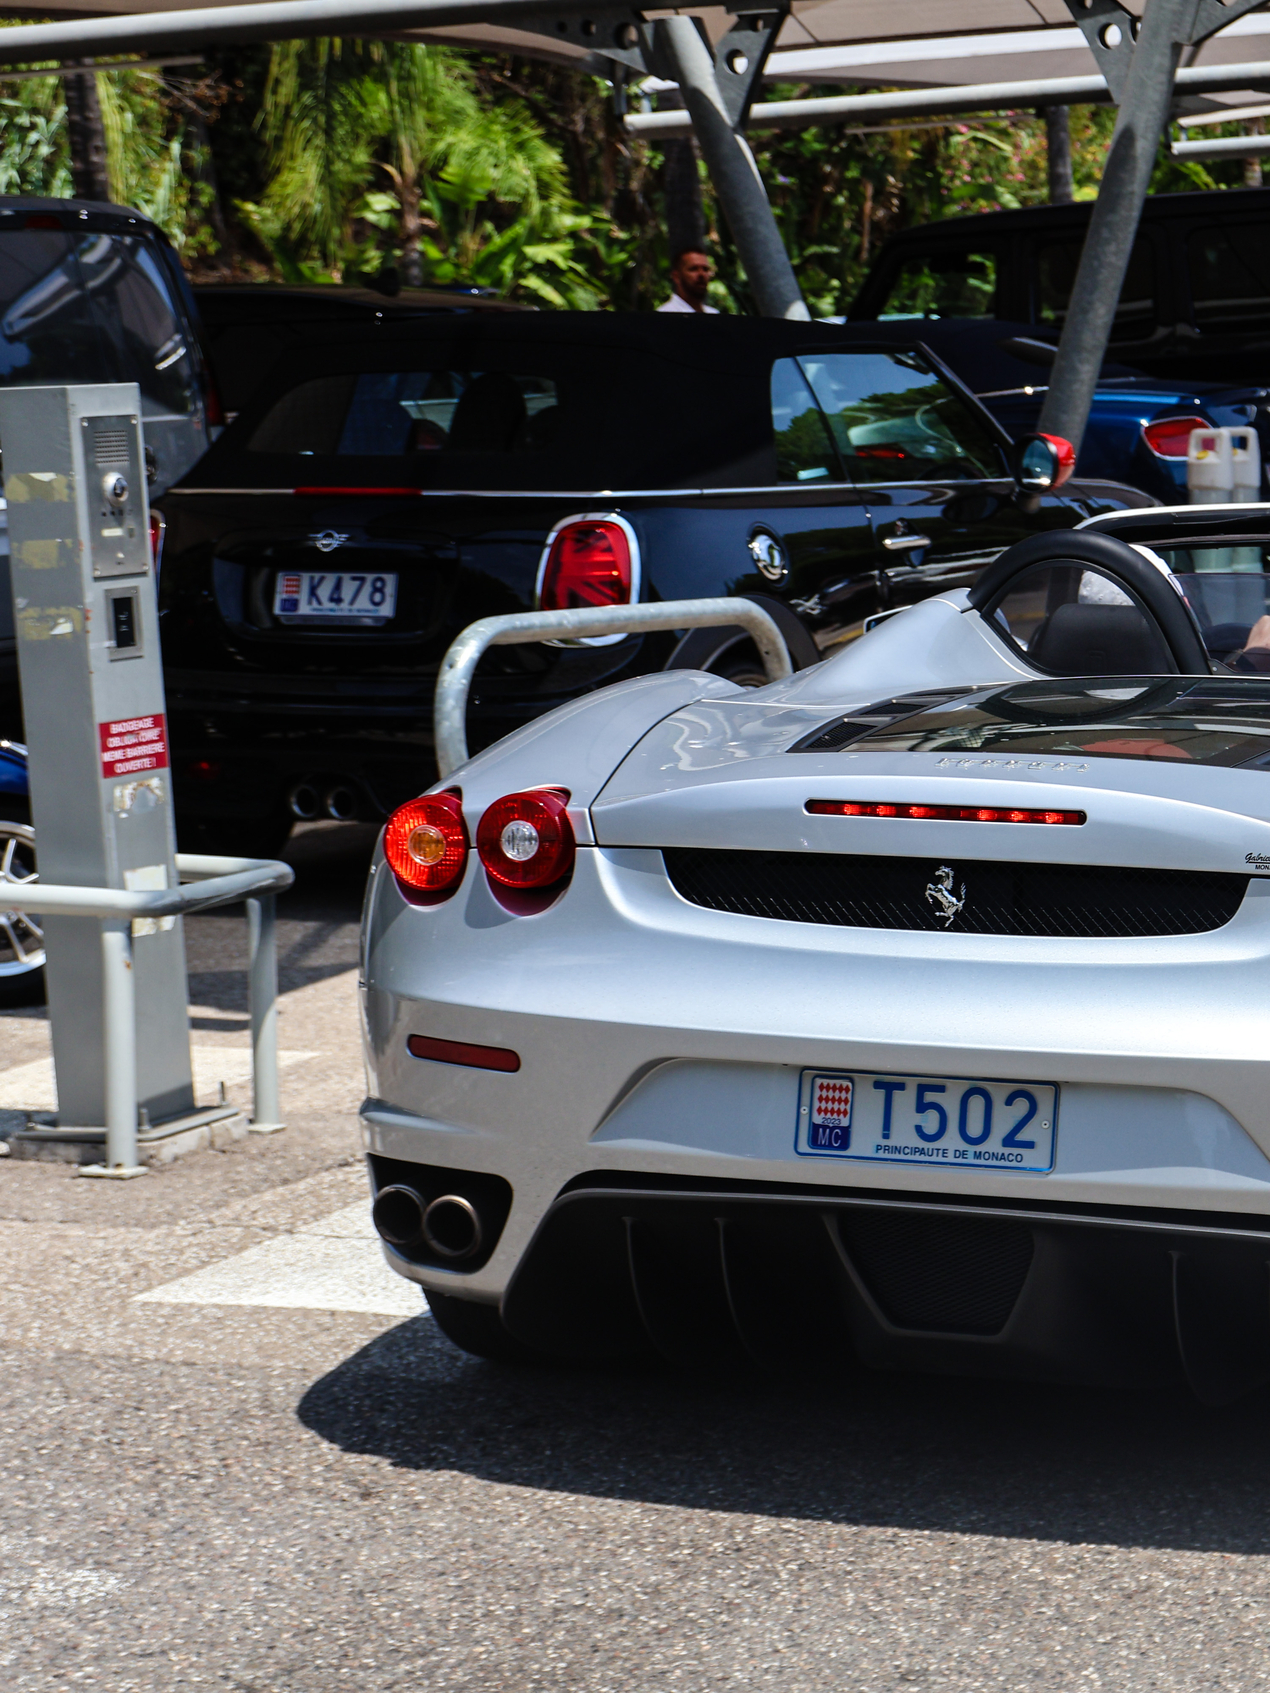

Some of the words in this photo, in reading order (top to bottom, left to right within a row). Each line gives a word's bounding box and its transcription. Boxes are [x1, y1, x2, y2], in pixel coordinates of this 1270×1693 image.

[307, 575, 386, 607] K478
[821, 1116, 842, 1127] 2023
[872, 1080, 1039, 1150] T502
[817, 1127, 842, 1148] MC
[875, 1143, 950, 1160] PRINCIPAUTE
[953, 1149, 969, 1161] DE
[972, 1150, 1025, 1165] MONACO
